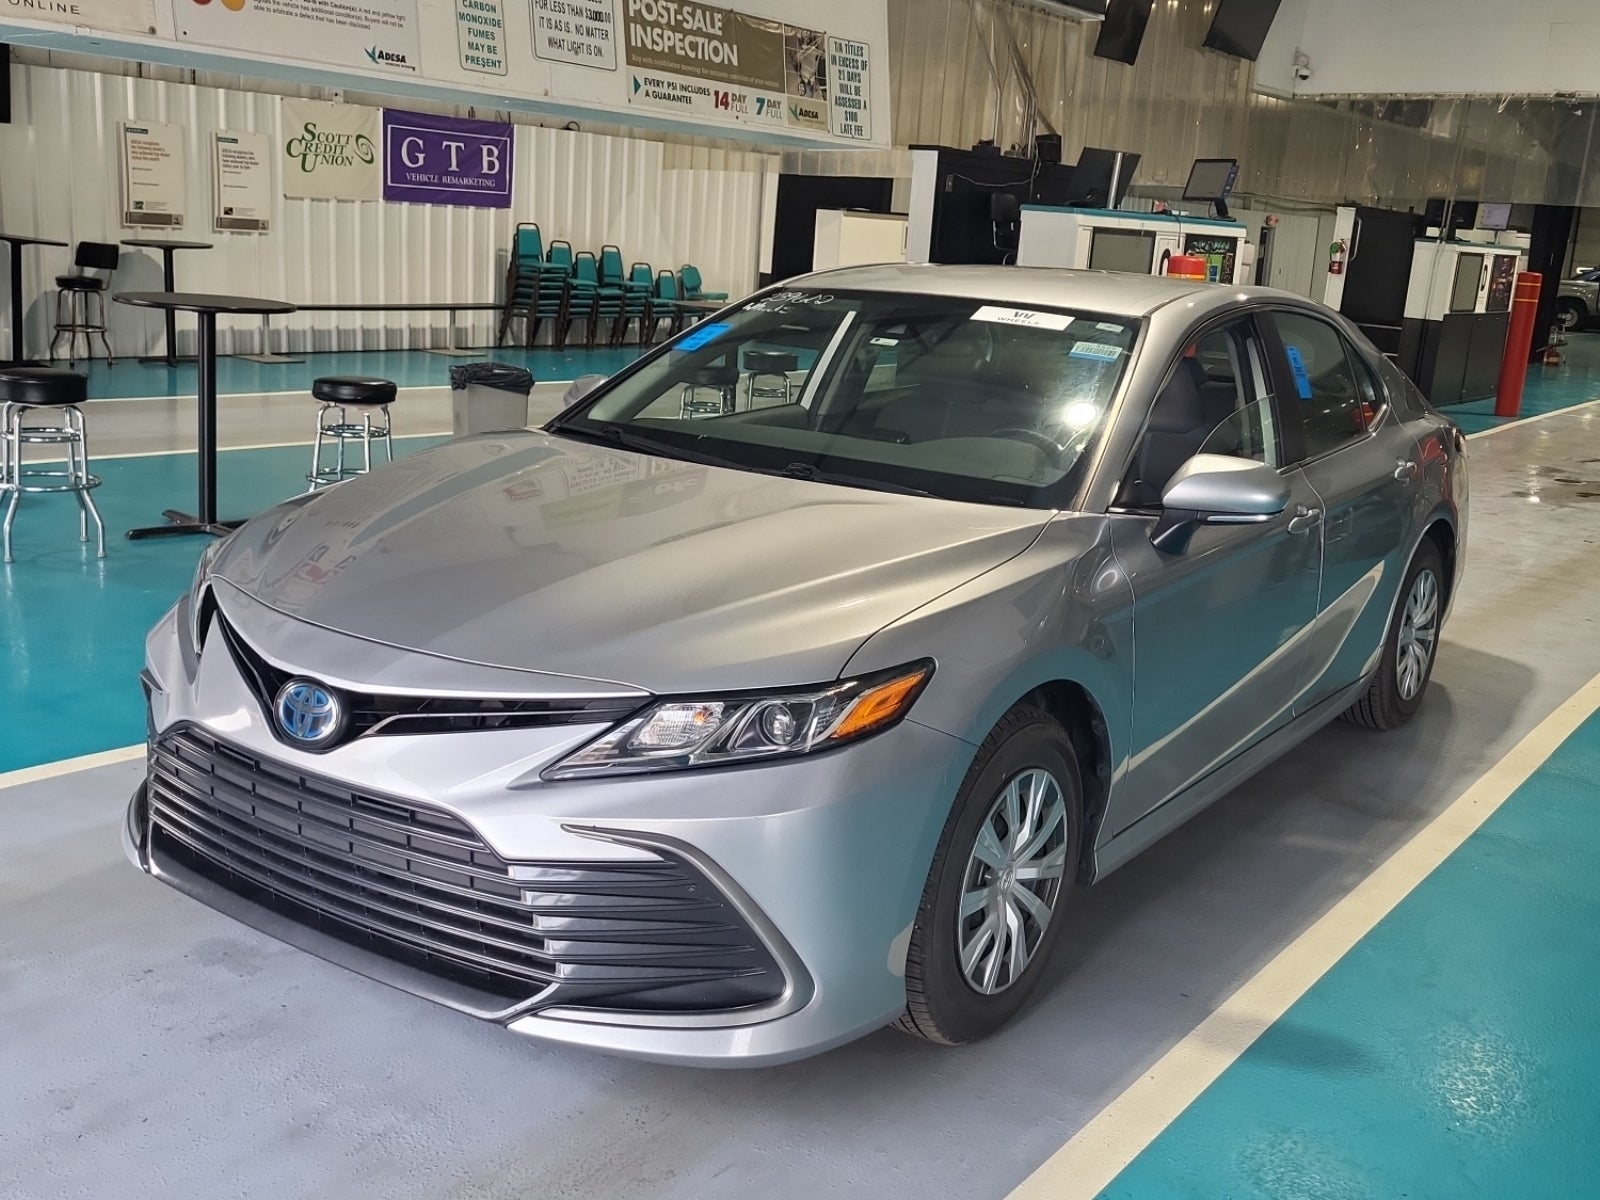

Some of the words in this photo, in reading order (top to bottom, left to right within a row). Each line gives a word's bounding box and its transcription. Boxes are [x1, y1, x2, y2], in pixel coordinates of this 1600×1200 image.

[8, 0, 80, 14] ONLINE
[462, 0, 496, 13] CARBON
[535, 0, 548, 11] FOR
[550, 0, 565, 14] LESS
[567, 4, 583, 18] THAN
[459, 12, 502, 28] MONOXIDE
[628, 0, 722, 36] POST-SALE
[468, 27, 495, 41] FUMES
[539, 16, 544, 28] IT
[546, 18, 553, 30] IS
[554, 19, 562, 32] AS
[575, 24, 584, 36] NO
[585, 26, 609, 41] MATTER
[468, 41, 485, 52] MAY
[487, 45, 497, 55] BE
[547, 36, 565, 51] WHAT
[567, 40, 584, 54] LIGHT
[586, 44, 592, 56] IS
[630, 23, 738, 67] INSPECTION
[845, 42, 864, 57] TITLES
[378, 50, 406, 63] ADESA
[465, 54, 502, 68] PRESENT
[831, 54, 837, 66] IN
[838, 55, 860, 70] EXCESS
[861, 60, 868, 71] OF
[838, 69, 845, 80] 21
[847, 70, 861, 83] DAYS
[644, 77, 665, 88] EVERY
[667, 82, 677, 91] PSI
[680, 84, 710, 96] INCLUDES
[839, 83, 852, 95] WILL
[854, 85, 861, 96] BE
[652, 90, 692, 104] GUARANTEE
[714, 90, 730, 110] 14
[731, 93, 747, 104] DAY
[835, 95, 861, 109] ASSESSED
[863, 100, 867, 110] A
[731, 102, 748, 114] FULL
[756, 97, 765, 115] 7
[767, 99, 782, 110] DAY
[766, 108, 782, 119] FULL
[844, 110, 858, 122] $100
[301, 122, 352, 145] SCOTT
[840, 123, 852, 135] LATE
[854, 125, 863, 136] FEE
[286, 138, 346, 158] CREDIT
[401, 137, 426, 168] G
[442, 141, 464, 171] T
[480, 145, 500, 174] B
[300, 153, 353, 173] UNION
[406, 172, 439, 183] VEHICLE
[442, 176, 495, 187] REMARKETING
[997, 317, 1040, 325] WHEELS
